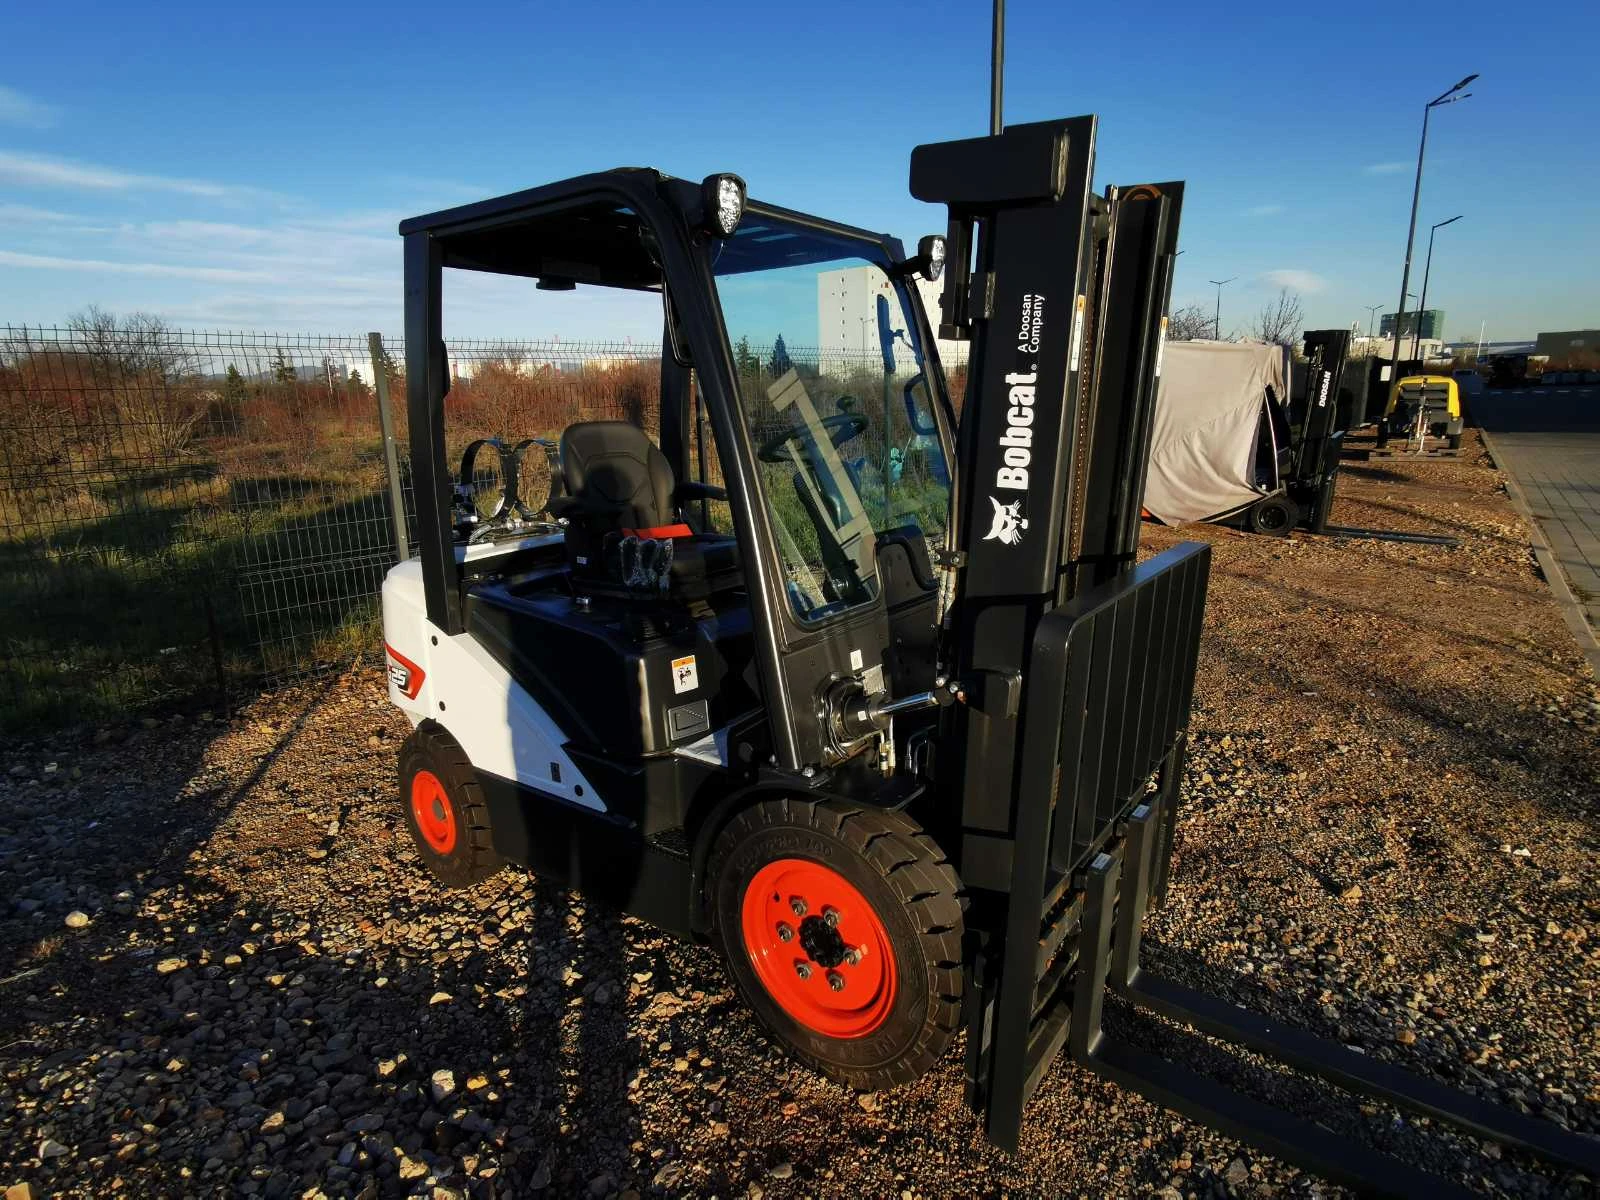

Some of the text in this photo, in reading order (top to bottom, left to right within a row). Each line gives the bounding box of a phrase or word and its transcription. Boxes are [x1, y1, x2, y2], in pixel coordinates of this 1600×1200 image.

[1018, 294, 1033, 353] A Doosan
[1028, 294, 1045, 353] Company
[1318, 371, 1332, 408] DOOSAN
